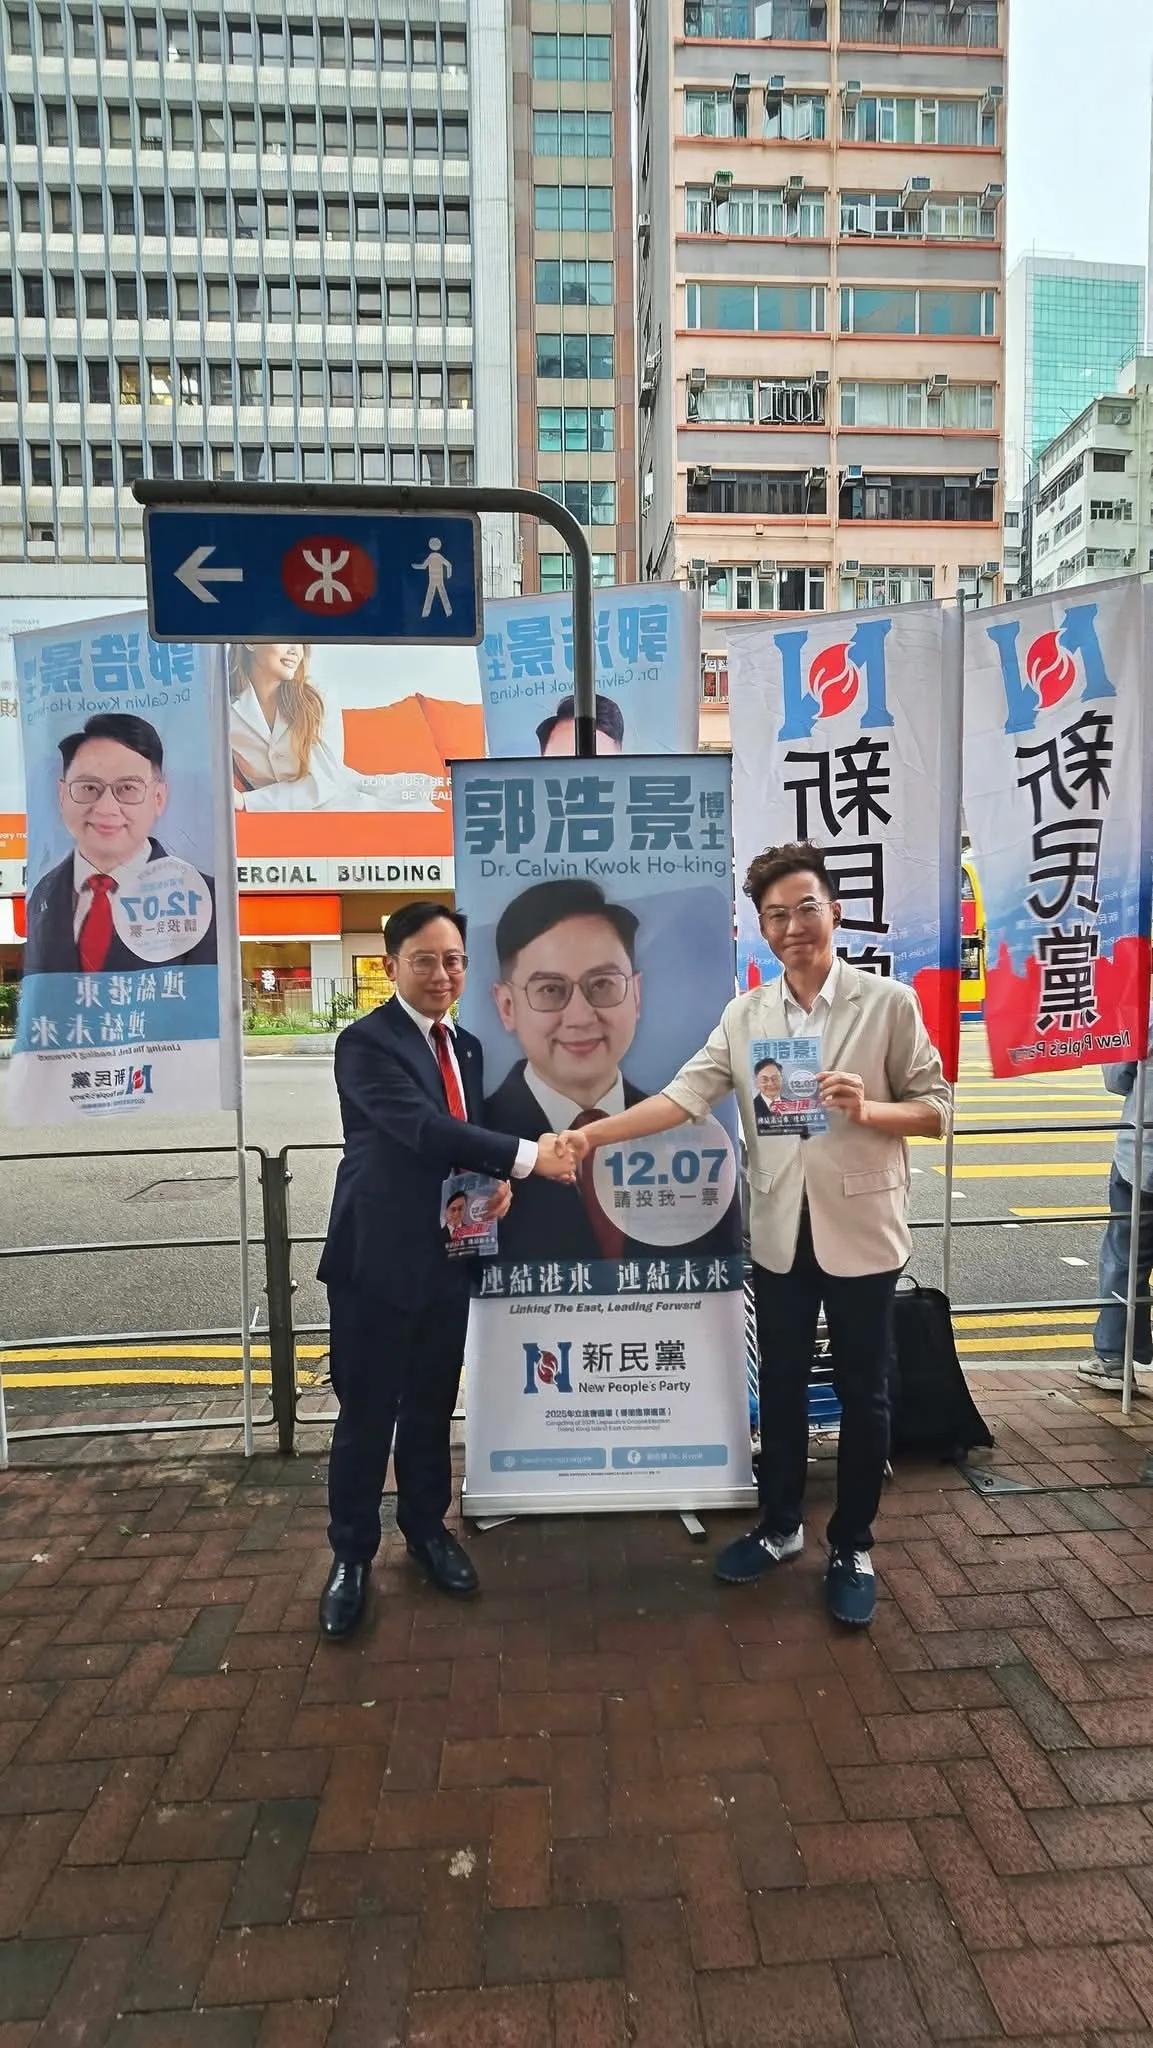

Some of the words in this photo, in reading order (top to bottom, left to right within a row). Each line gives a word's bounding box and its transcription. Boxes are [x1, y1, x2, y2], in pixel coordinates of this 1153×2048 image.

[402, 791, 416, 800] BE
[464, 776, 695, 855] 郭浩景
[699, 791, 725, 850] 博士
[338, 865, 441, 882] BUILDING
[481, 859, 510, 877] Dr.
[515, 858, 578, 877] Calvin
[585, 857, 640, 876] Kwok
[647, 855, 726, 877] Ho-king
[604, 1149, 728, 1187] 12.07
[614, 1188, 719, 1209] 請投我一票
[480, 1262, 592, 1295] 連結港東
[616, 1258, 730, 1293] 連結未來
[509, 1302, 551, 1315] Linking
[554, 1303, 573, 1313] The
[575, 1302, 604, 1314] East,
[607, 1301, 653, 1314] Leading
[656, 1300, 701, 1312] Forward
[582, 1340, 686, 1372] 新民黨
[579, 1382, 604, 1394] New
[608, 1381, 656, 1395] People's
[659, 1380, 691, 1394] Party
